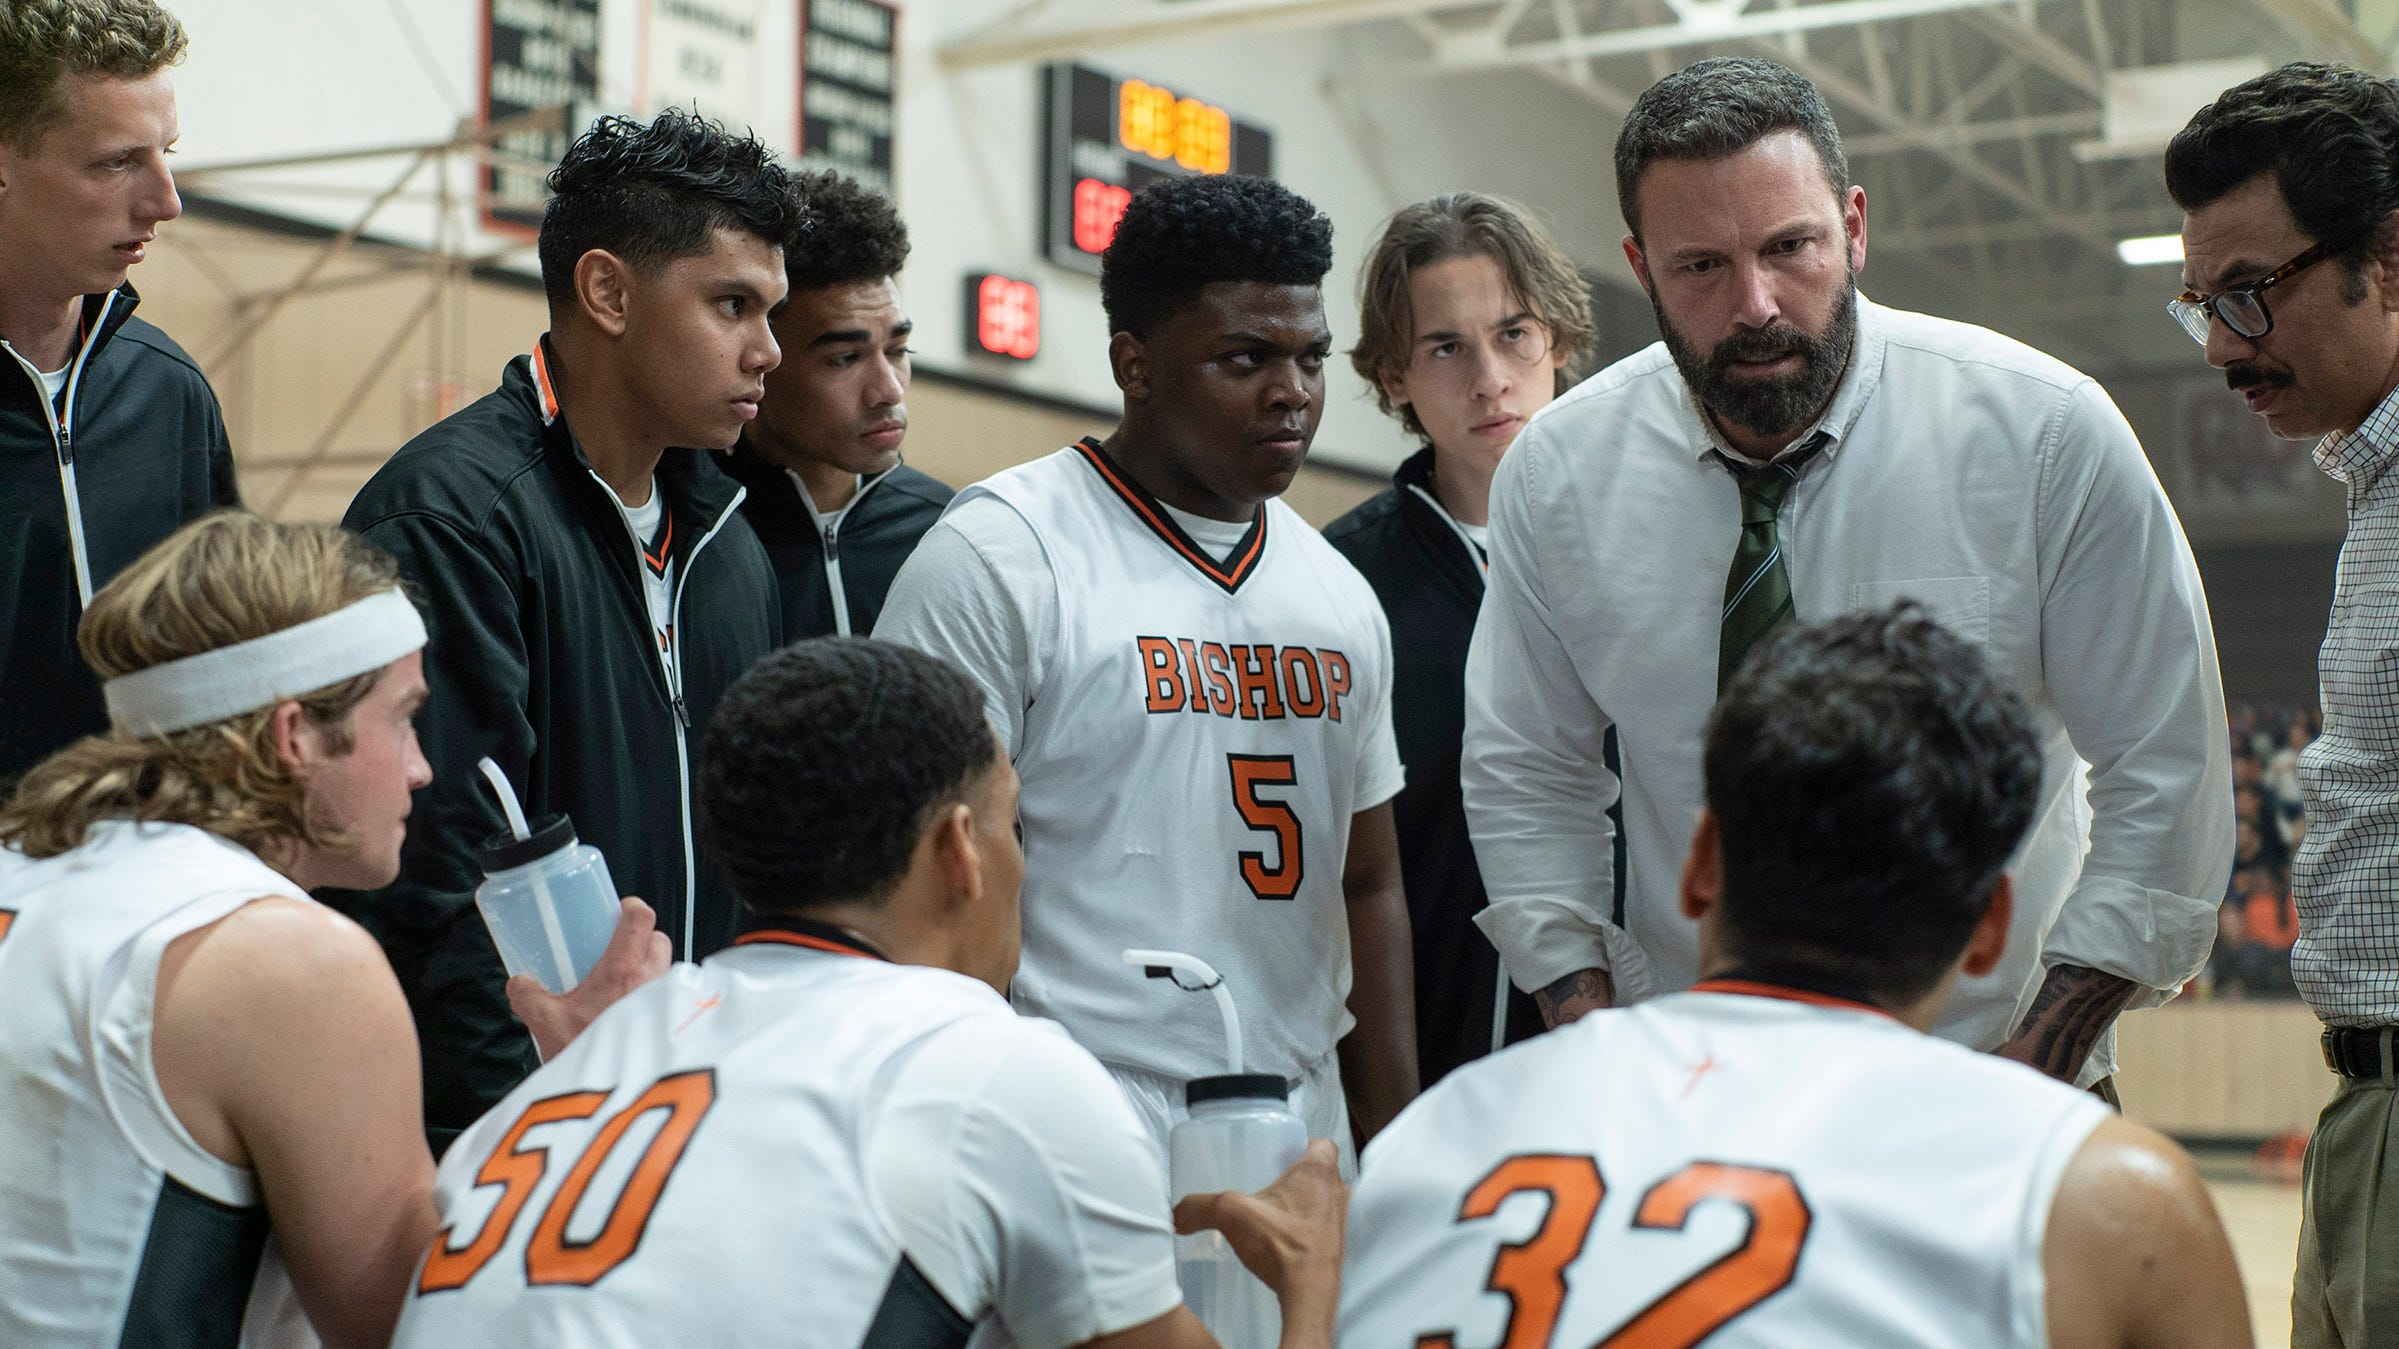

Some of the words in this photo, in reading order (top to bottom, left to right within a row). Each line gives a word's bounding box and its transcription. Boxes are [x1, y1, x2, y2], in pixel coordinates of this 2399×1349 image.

[1136, 635, 1352, 724] BISHOP
[1226, 752, 1305, 901] 5
[416, 1066, 718, 1297] 50
[1412, 1152, 1814, 1349] 32
